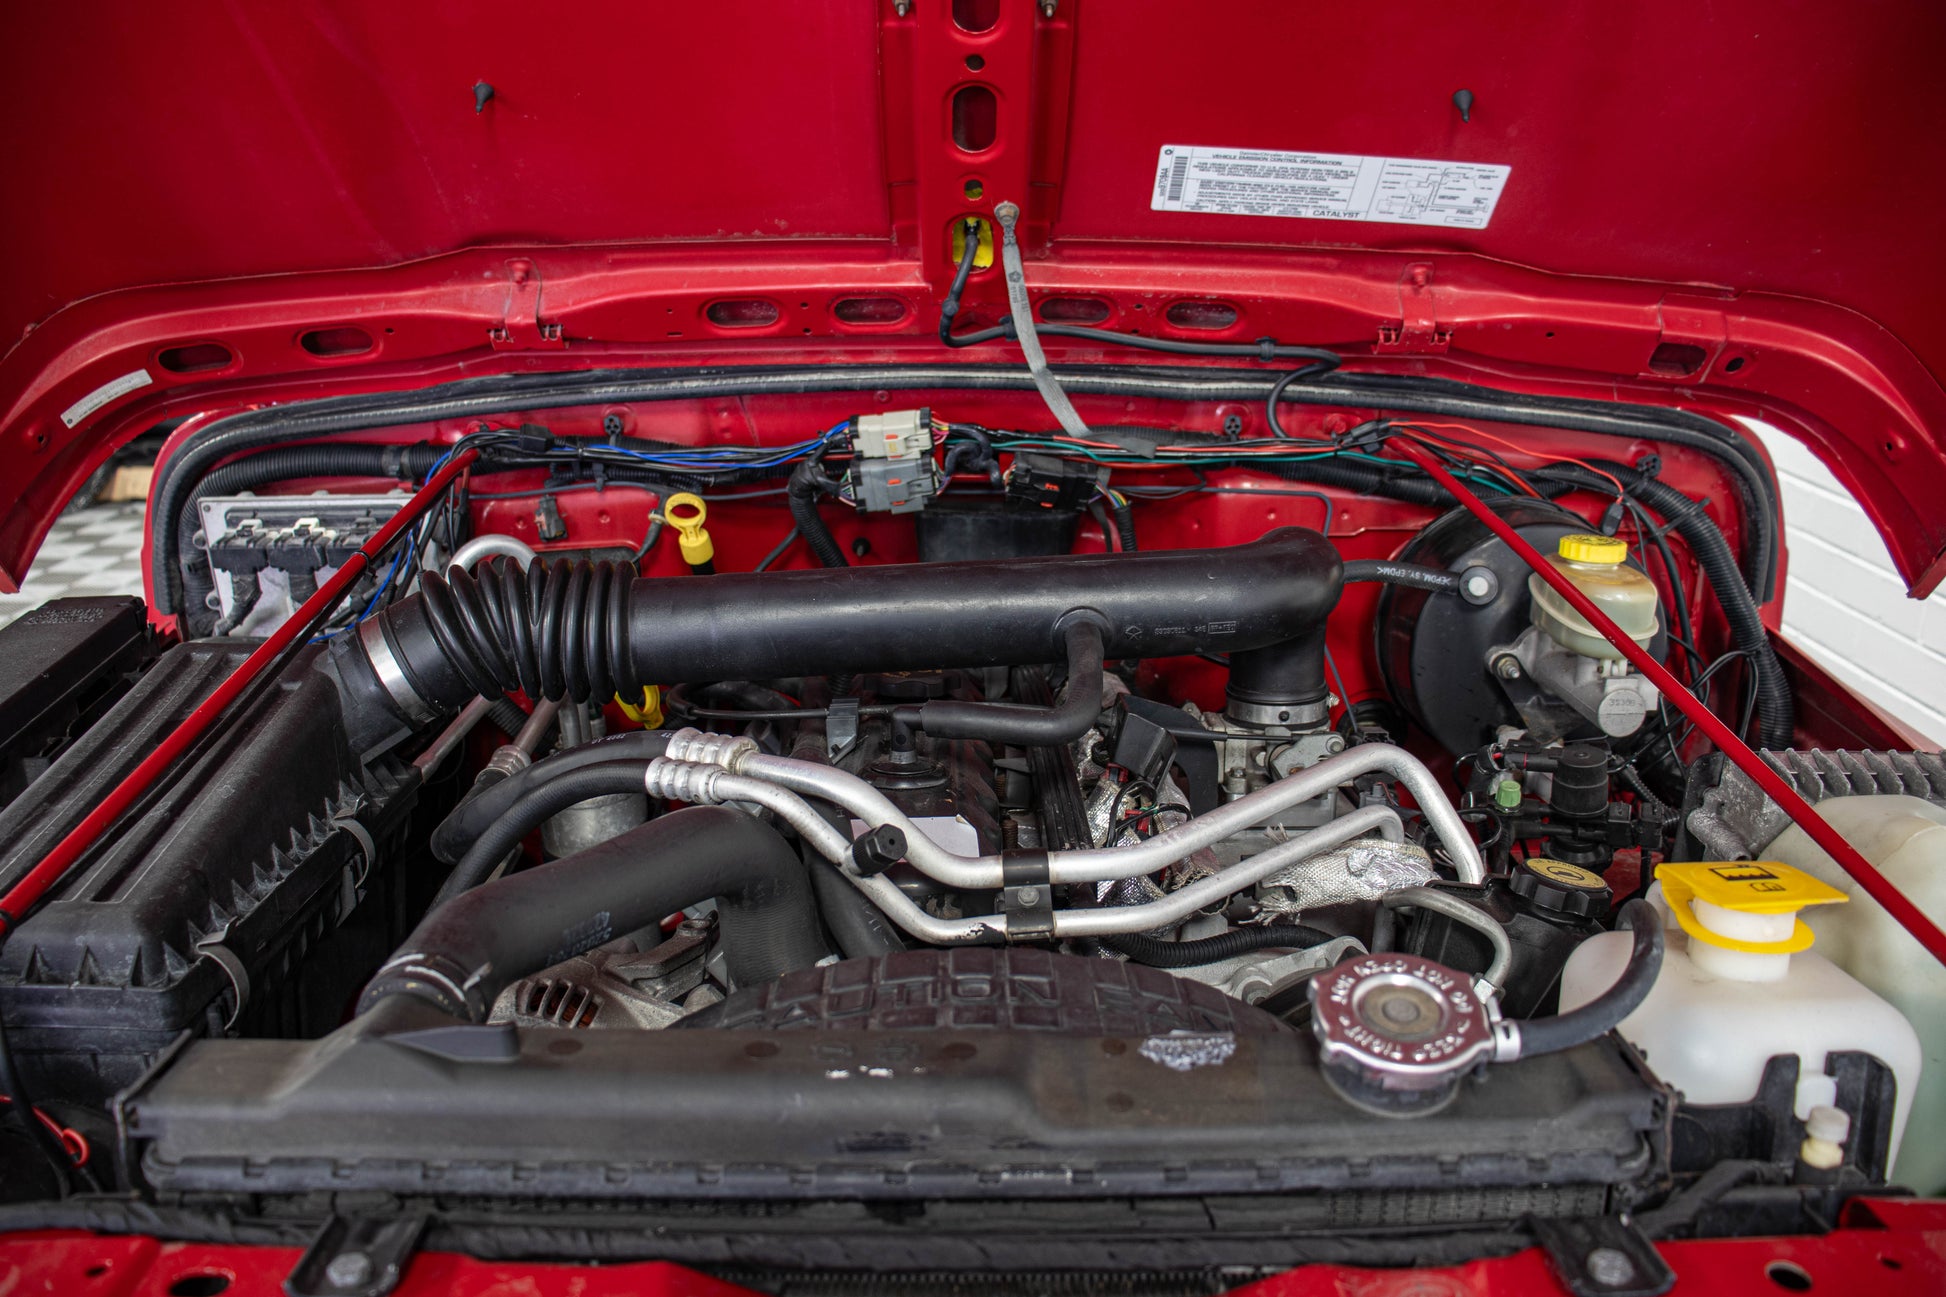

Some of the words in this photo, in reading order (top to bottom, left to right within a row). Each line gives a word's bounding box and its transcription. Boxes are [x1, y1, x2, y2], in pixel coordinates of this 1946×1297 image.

[1299, 158, 1343, 166] INFORMATION
[1312, 209, 1360, 219] CATALYST
[1412, 964, 1454, 990] NOT
[1093, 983, 1236, 1033] FAN
[1344, 1025, 1404, 1061] TIGHT
